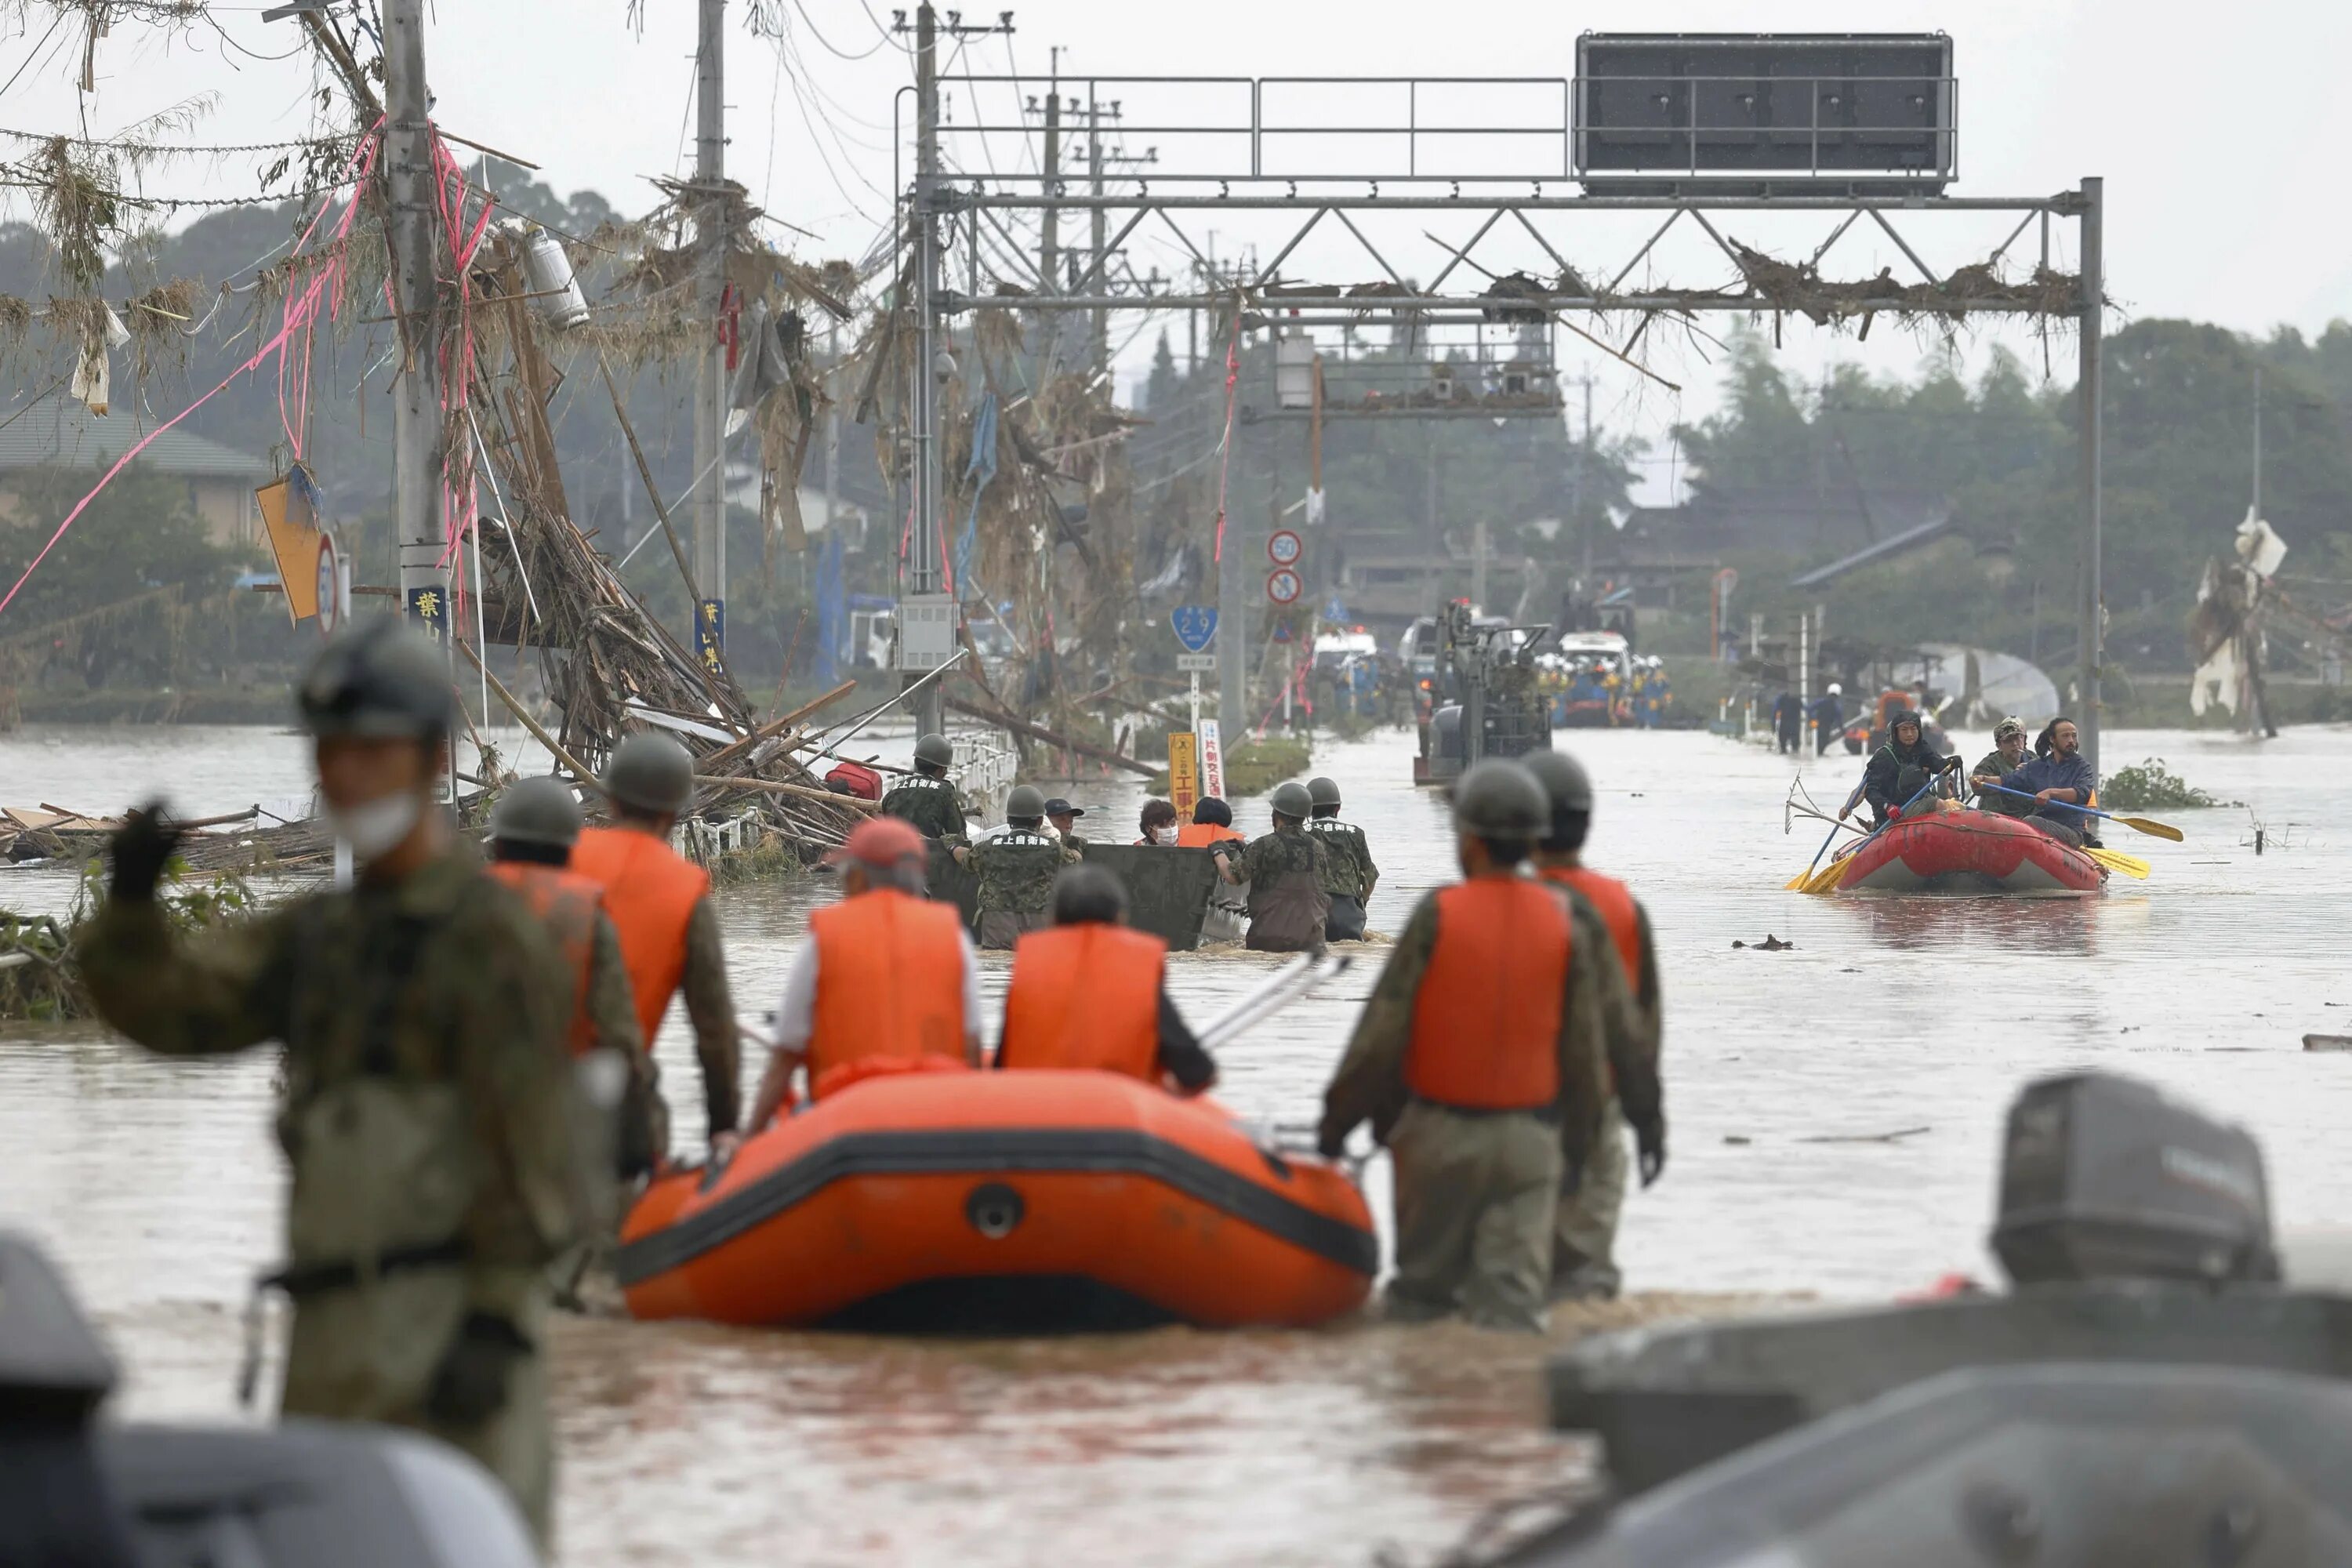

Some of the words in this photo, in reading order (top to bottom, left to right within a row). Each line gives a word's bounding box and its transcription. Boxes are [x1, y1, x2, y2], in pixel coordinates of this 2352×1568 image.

[993, 835, 1050, 846] 陸上自衛隊
